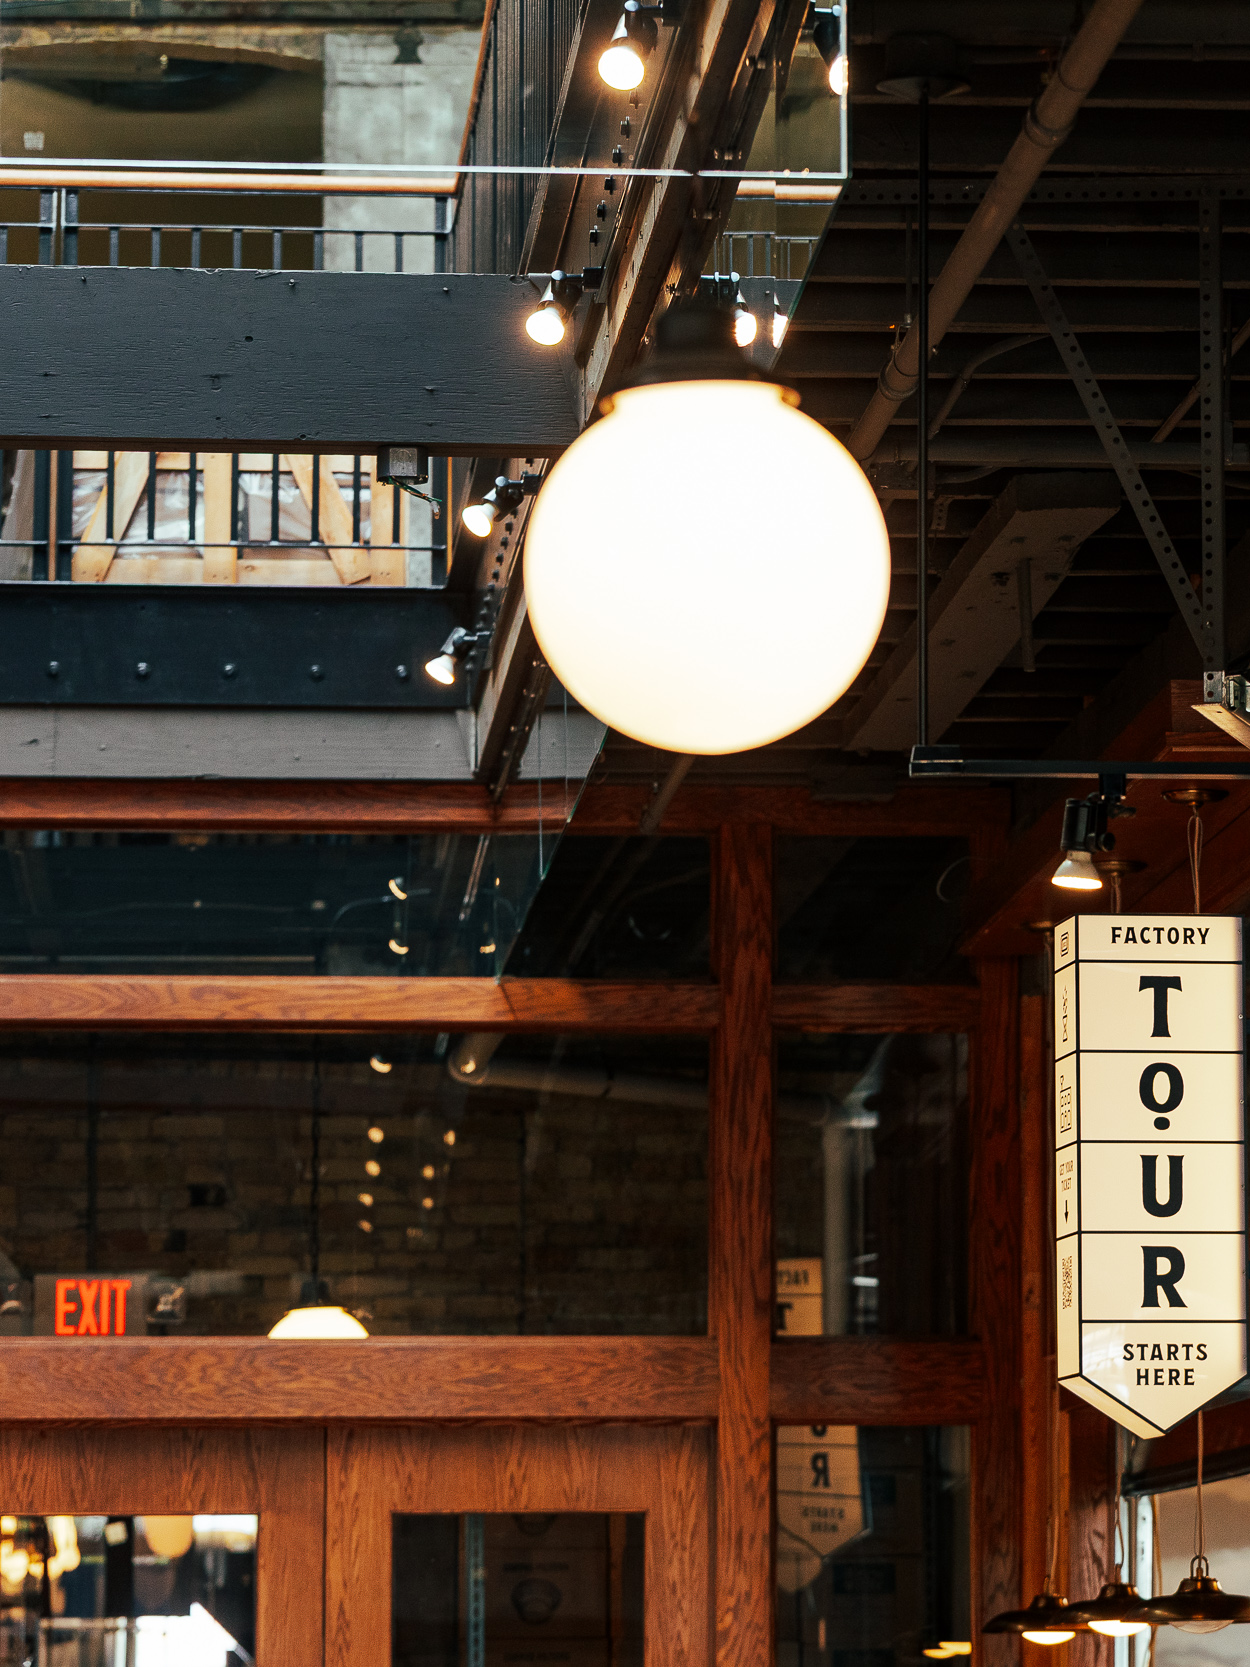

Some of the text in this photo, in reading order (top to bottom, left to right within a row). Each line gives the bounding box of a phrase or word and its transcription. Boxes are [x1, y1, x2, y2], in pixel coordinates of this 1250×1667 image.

[1110, 926, 1211, 945] FACTORY
[1138, 975, 1188, 1309] TOUR
[54, 1278, 132, 1336] EXIT
[1122, 1343, 1208, 1362] STARTS
[1136, 1367, 1196, 1386] HERE
